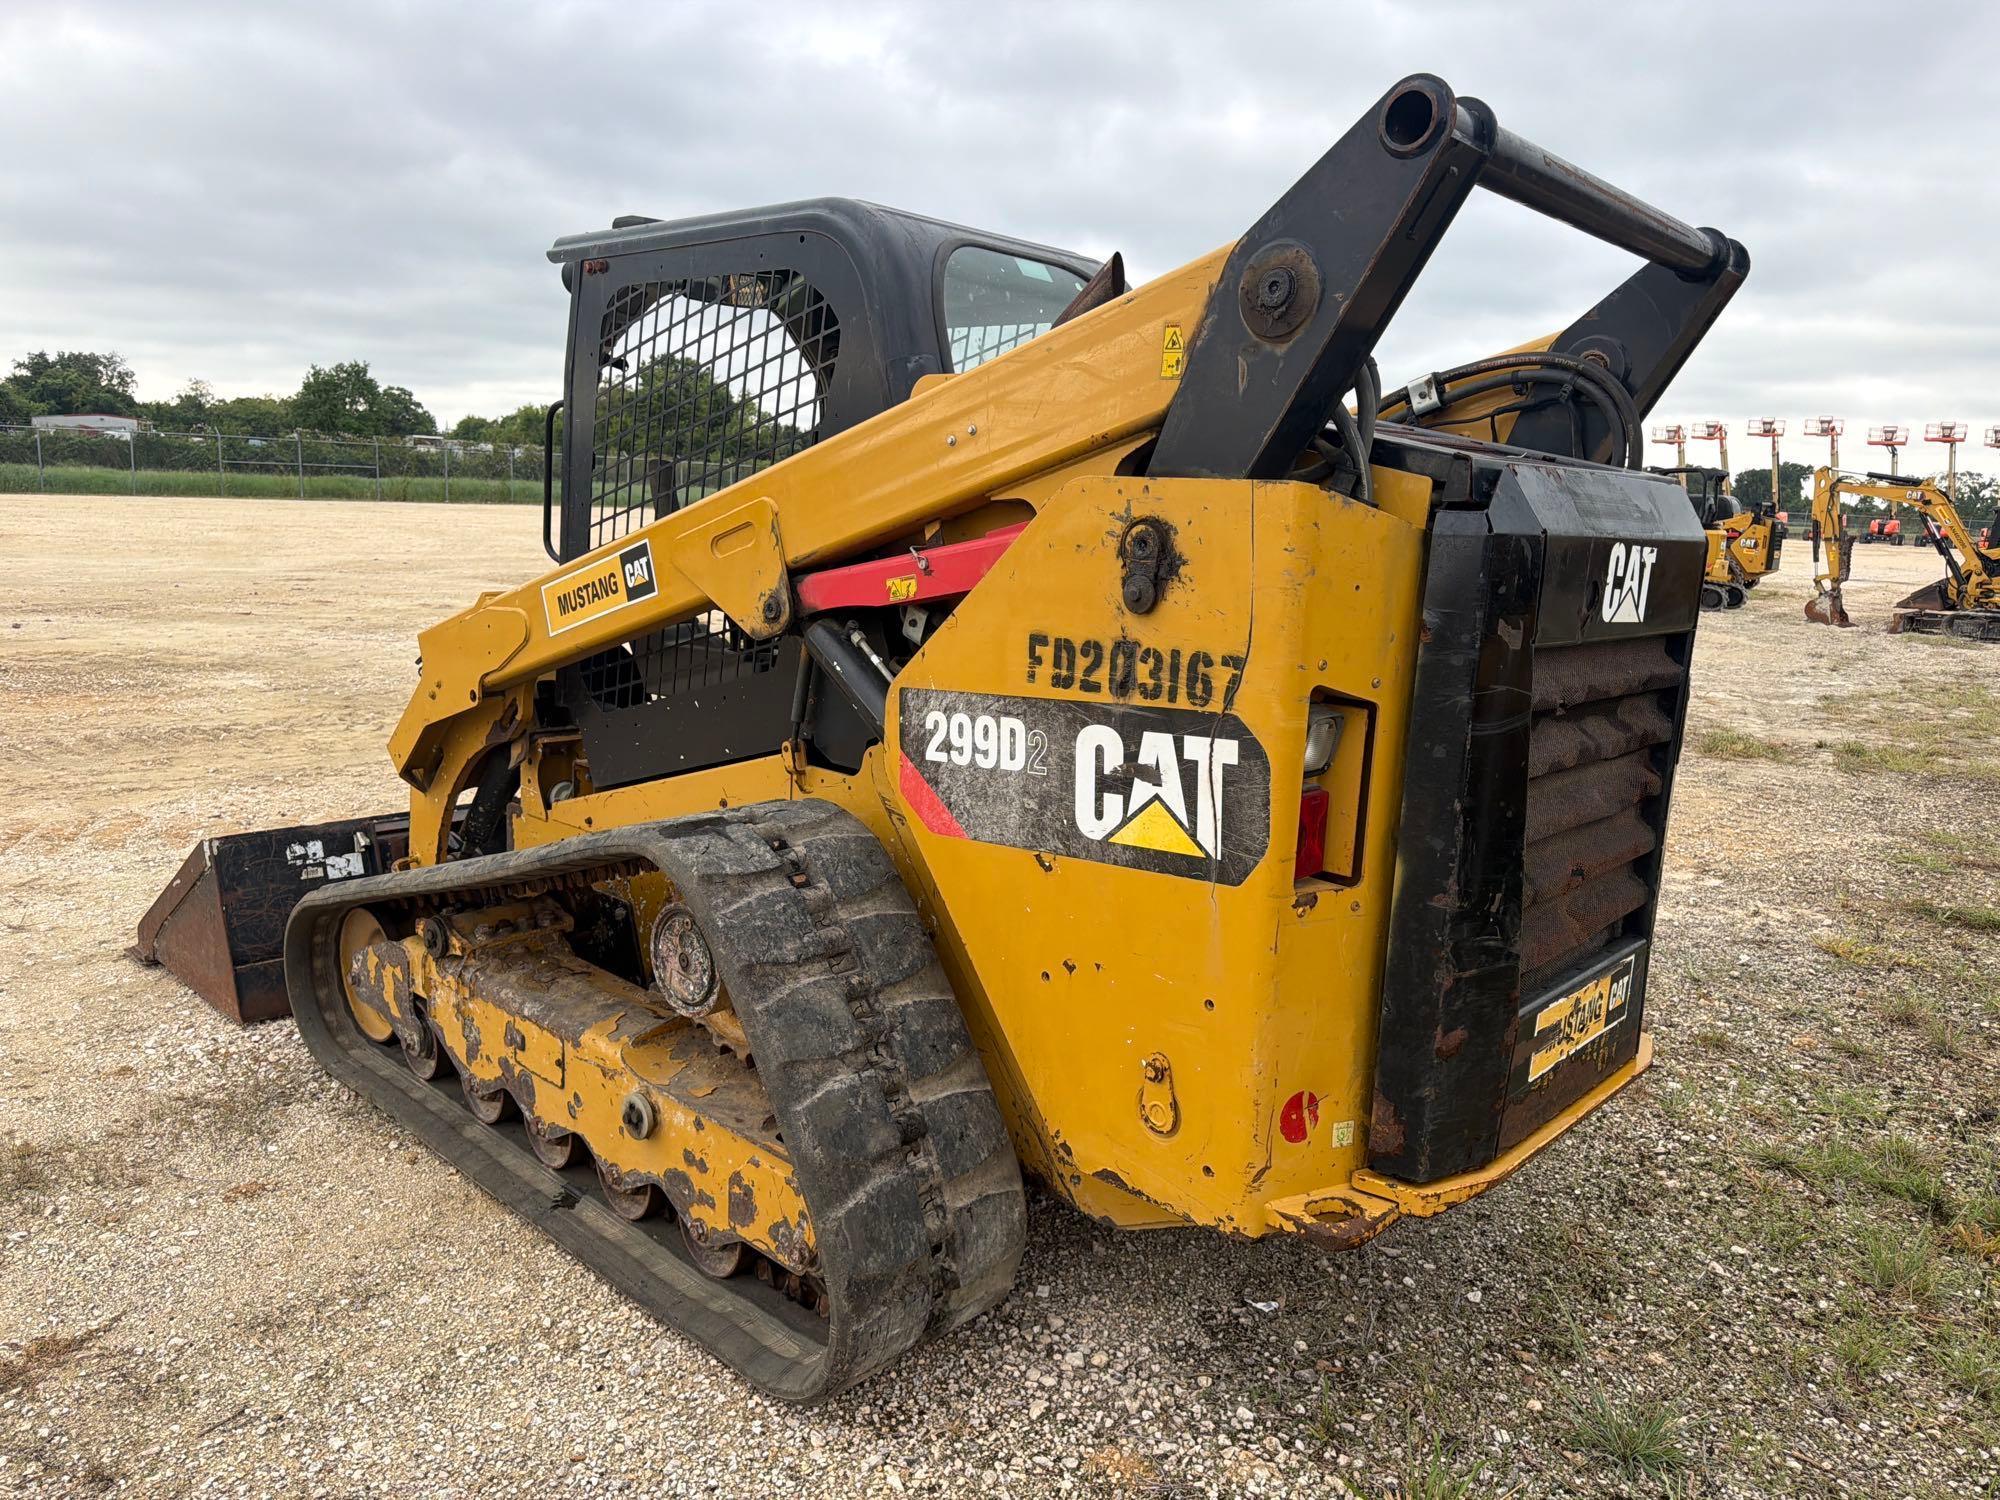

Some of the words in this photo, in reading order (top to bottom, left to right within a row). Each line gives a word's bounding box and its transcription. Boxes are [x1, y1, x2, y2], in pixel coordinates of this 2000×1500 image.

[1906, 490, 1923, 500] CAT
[1740, 538, 1756, 548] CAT
[557, 572, 619, 617] MUSTANG
[624, 556, 649, 588] CAT
[1602, 542, 1658, 623] CAT
[1027, 633, 1246, 711] FD203167
[925, 710, 1048, 776] 299D2
[1075, 724, 1239, 861] CAT
[1609, 975, 1630, 1011] CAT
